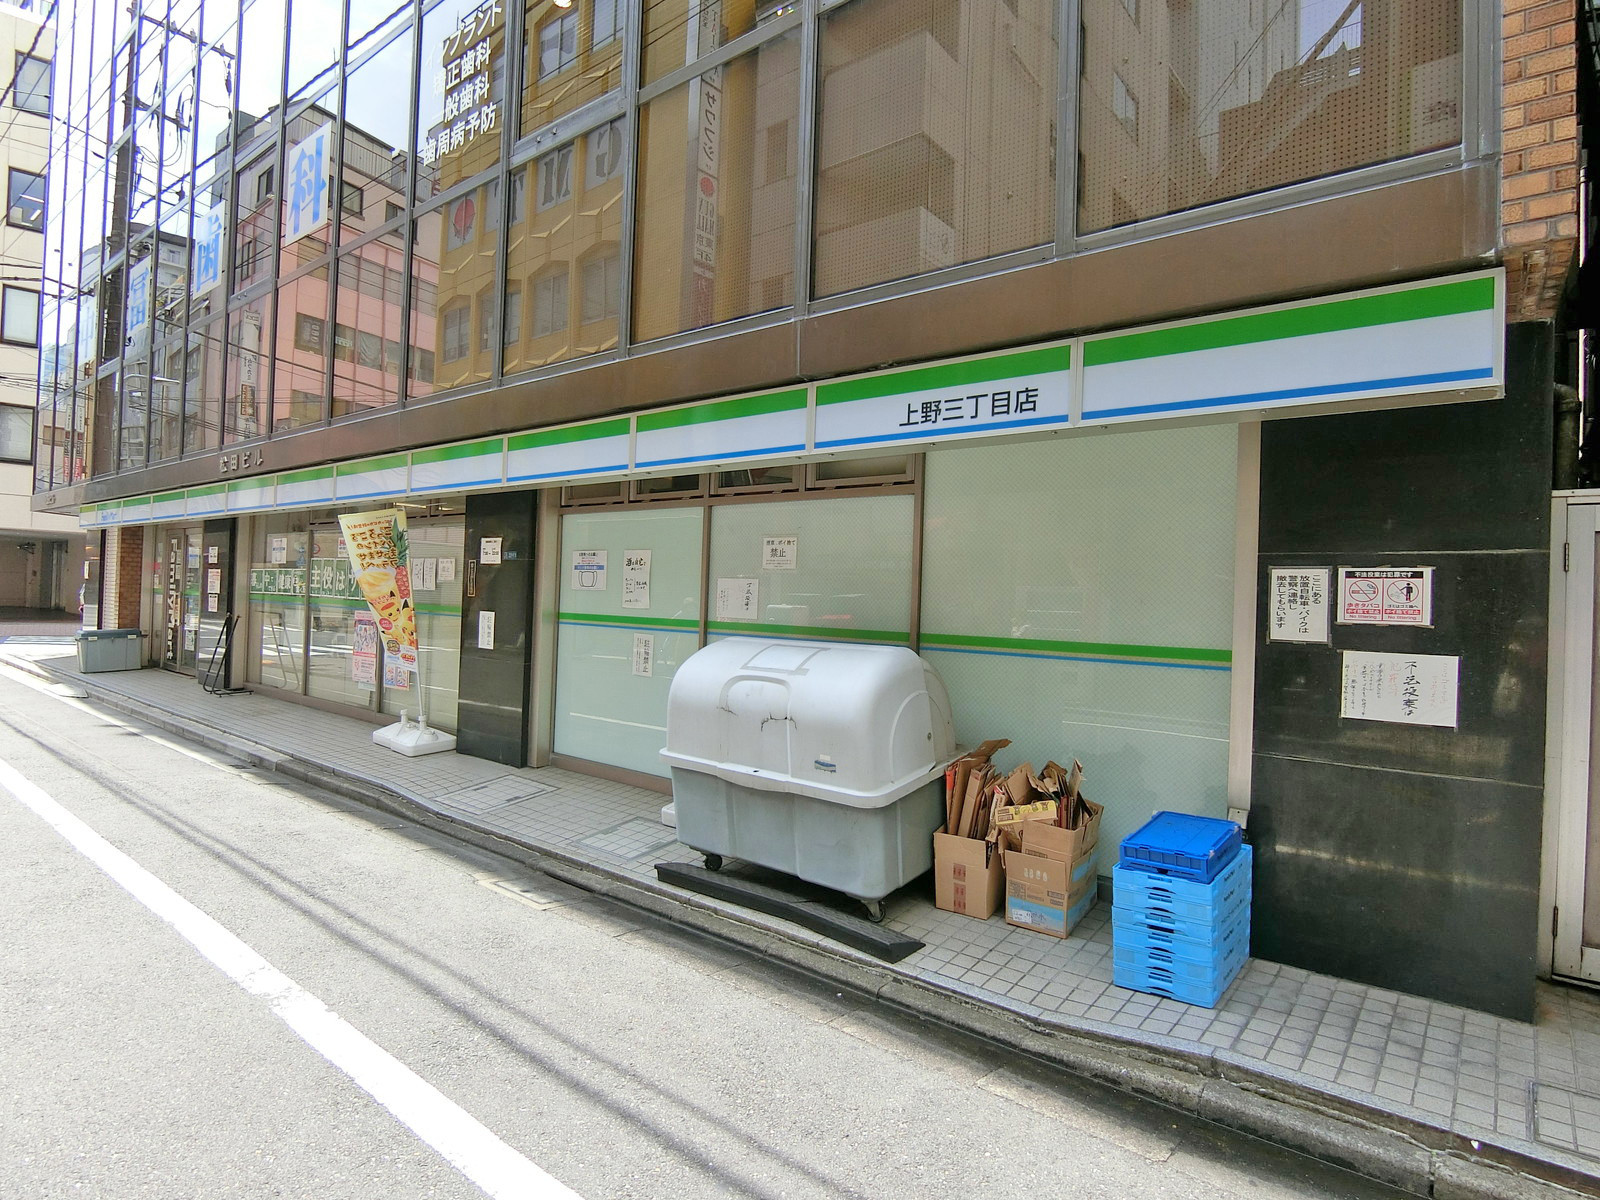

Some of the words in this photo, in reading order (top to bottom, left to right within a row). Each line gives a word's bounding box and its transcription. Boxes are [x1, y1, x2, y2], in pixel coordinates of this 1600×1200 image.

[423, 102, 496, 166] 歯周病予防
[899, 387, 1038, 426] 上野三丁目店
[770, 547, 787, 558] 禁止
[1276, 575, 1287, 629] 撤去してもらいます
[1288, 575, 1298, 610] 警察へ連絡し
[1299, 575, 1310, 634] 放置自転車・バイクは
[1312, 574, 1322, 605] ここにある
